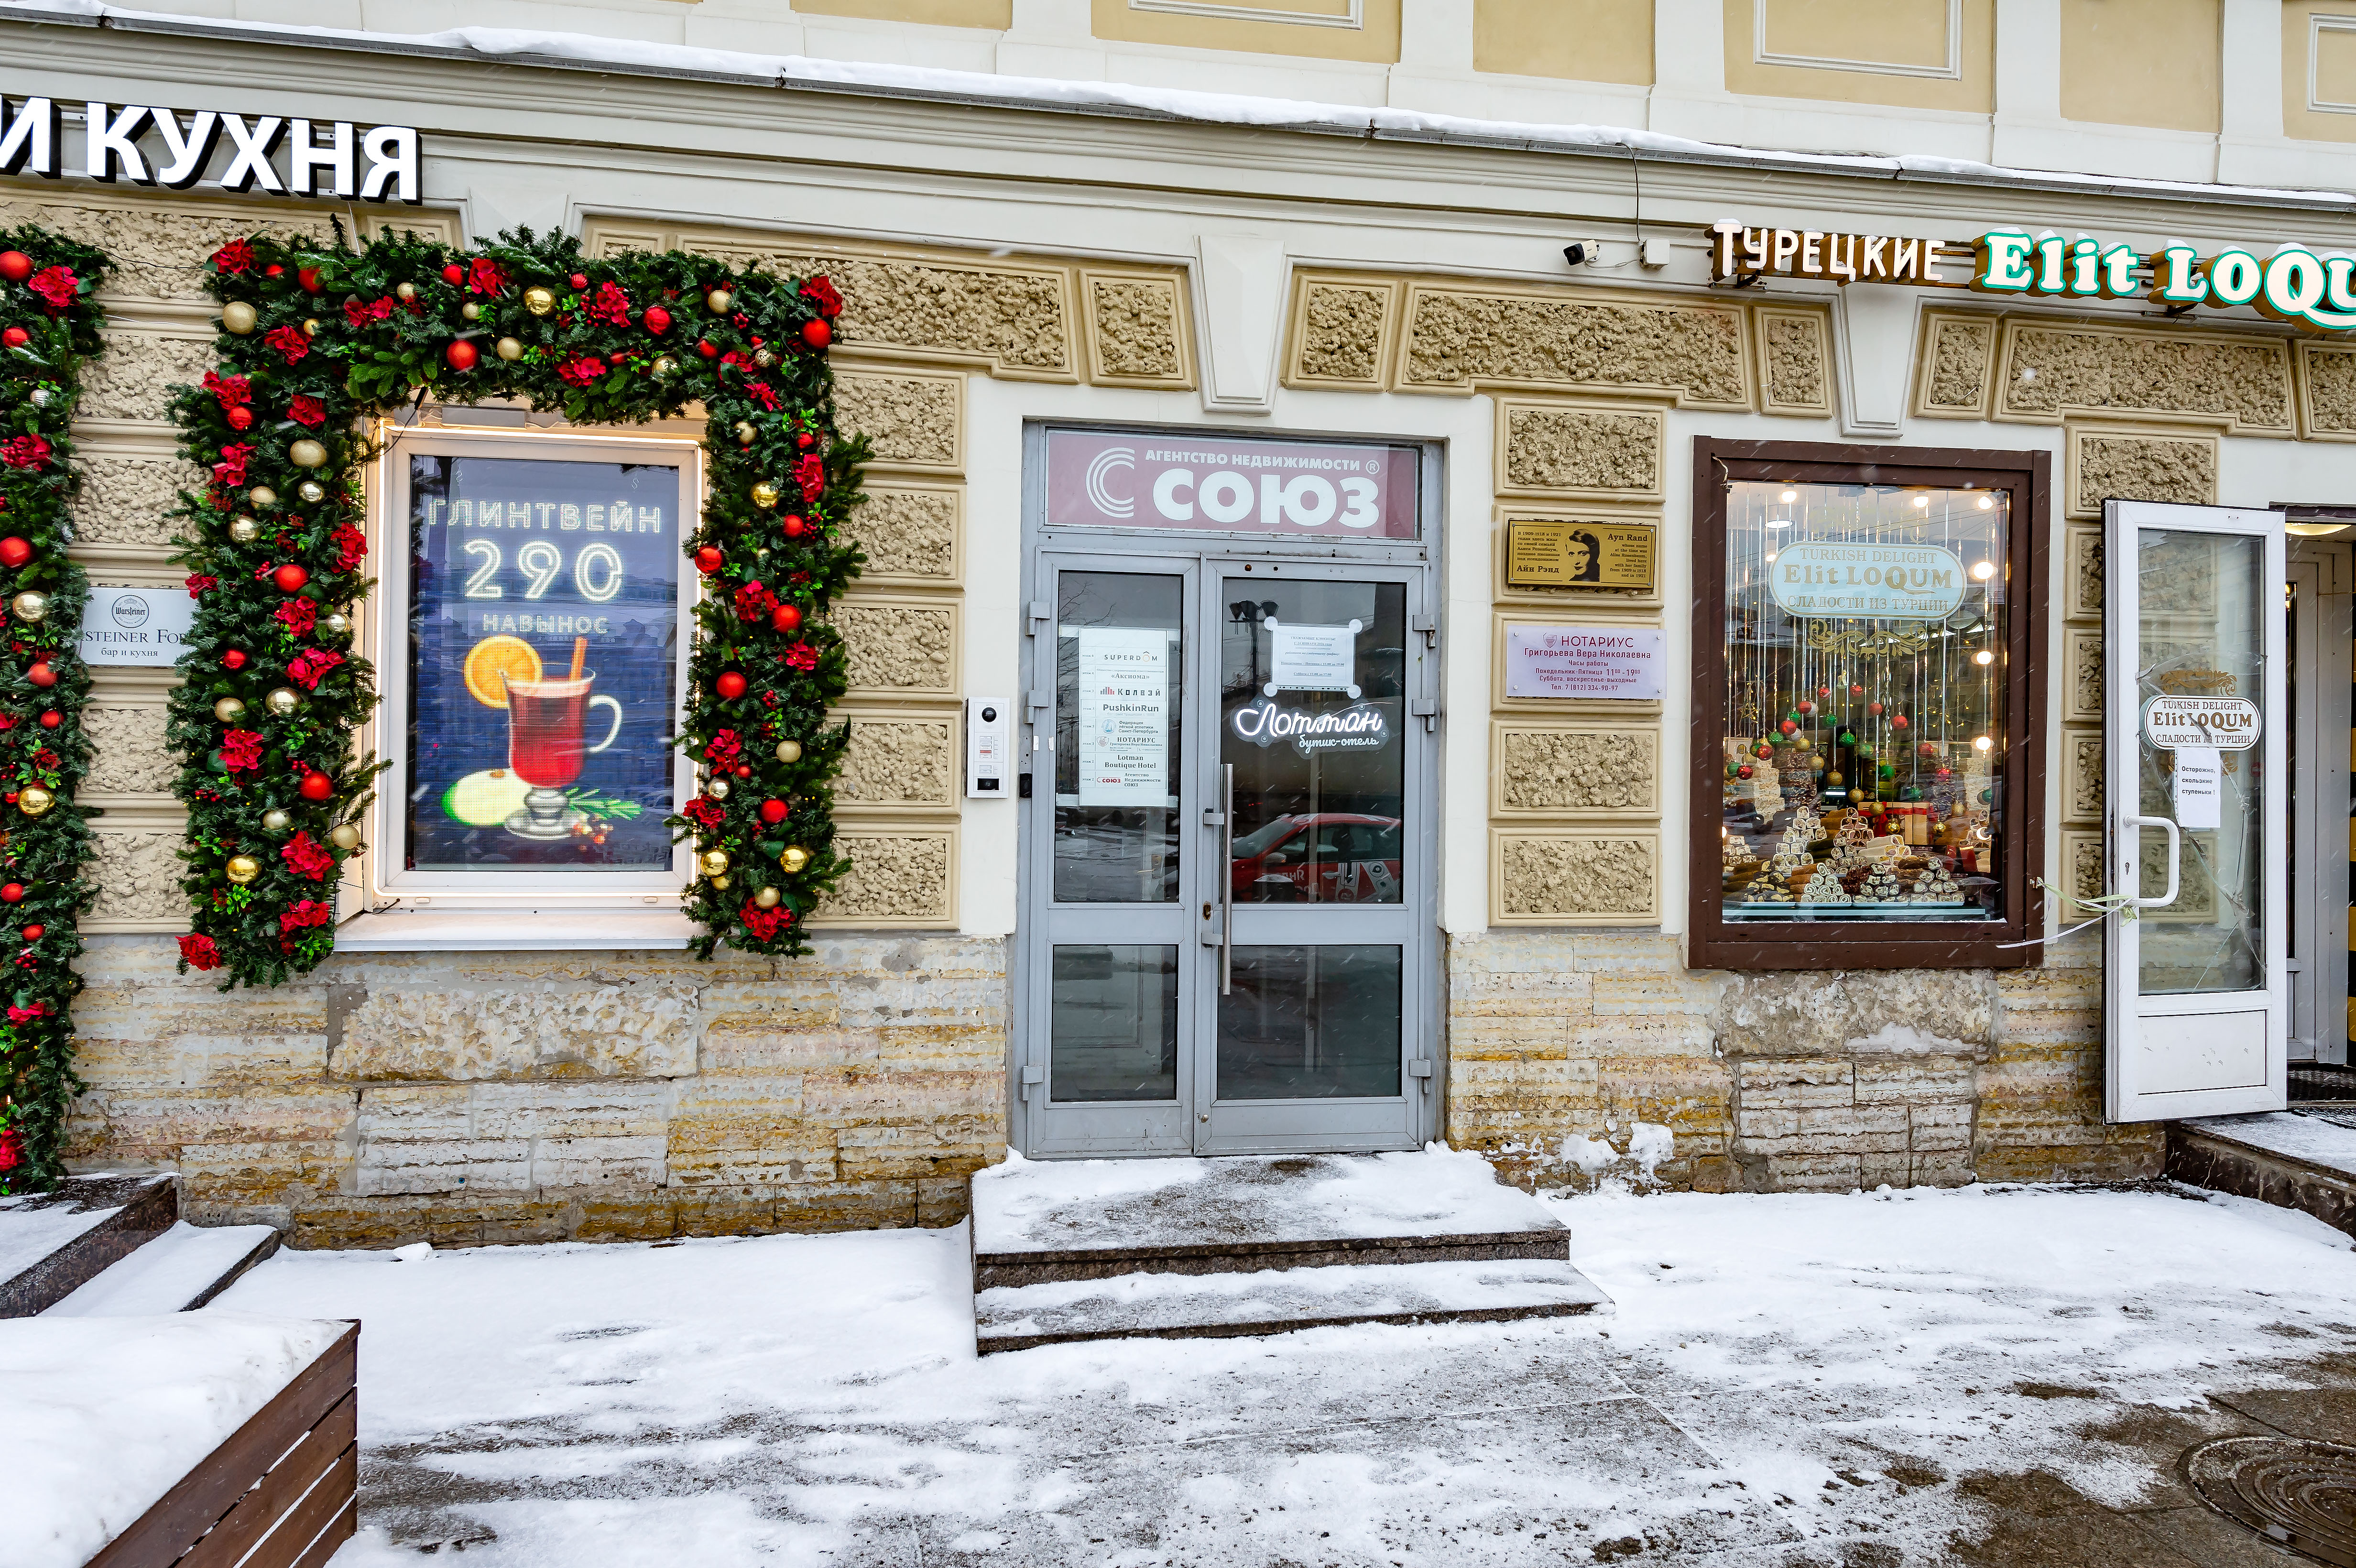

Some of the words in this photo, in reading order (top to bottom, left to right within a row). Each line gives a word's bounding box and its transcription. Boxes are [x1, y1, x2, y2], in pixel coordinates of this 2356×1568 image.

[87, 101, 417, 201] КУХНЯ
[1712, 222, 1945, 282] ТУРЕЦКИЕ
[1983, 231, 2140, 297] Elit
[1145, 449, 1229, 465] АГЕНТСТВО
[1232, 454, 1360, 471] НЕДВИЖИМОСТИ
[1152, 468, 1380, 529] СОЮЗ
[428, 498, 661, 534] ГЛИНТВЕЙН
[1608, 534, 1624, 542] Ayn
[1800, 548, 1866, 562] TURKISH
[1872, 551, 1937, 564] DELIGHT
[463, 538, 623, 602] 290
[1784, 564, 1838, 584] Elit
[1846, 566, 1952, 595] LOQUM
[116, 606, 146, 616] Warsteiner
[1788, 595, 1864, 609] СЛАДОСТИ
[1869, 598, 1887, 610] ИЗ
[1891, 598, 1948, 612] ТУРЦИИ
[483, 614, 608, 634] НАВЫНОС
[1561, 635, 1634, 647] НОТАРИУС
[101, 647, 118, 657] бар
[1524, 648, 1573, 658] Григорьева
[1577, 650, 1597, 658] Вера
[1600, 650, 1651, 659] Николаевна
[1103, 704, 1159, 712] PushkinRun
[2203, 702, 2243, 710] DELIGHT
[1236, 703, 1383, 737] Лотман
[2153, 712, 2185, 726] Elit
[1299, 734, 1379, 754] бутик-отель
[2156, 734, 2201, 743] СЛАДОСТИ
[2215, 735, 2250, 744] ТУРЦИИ
